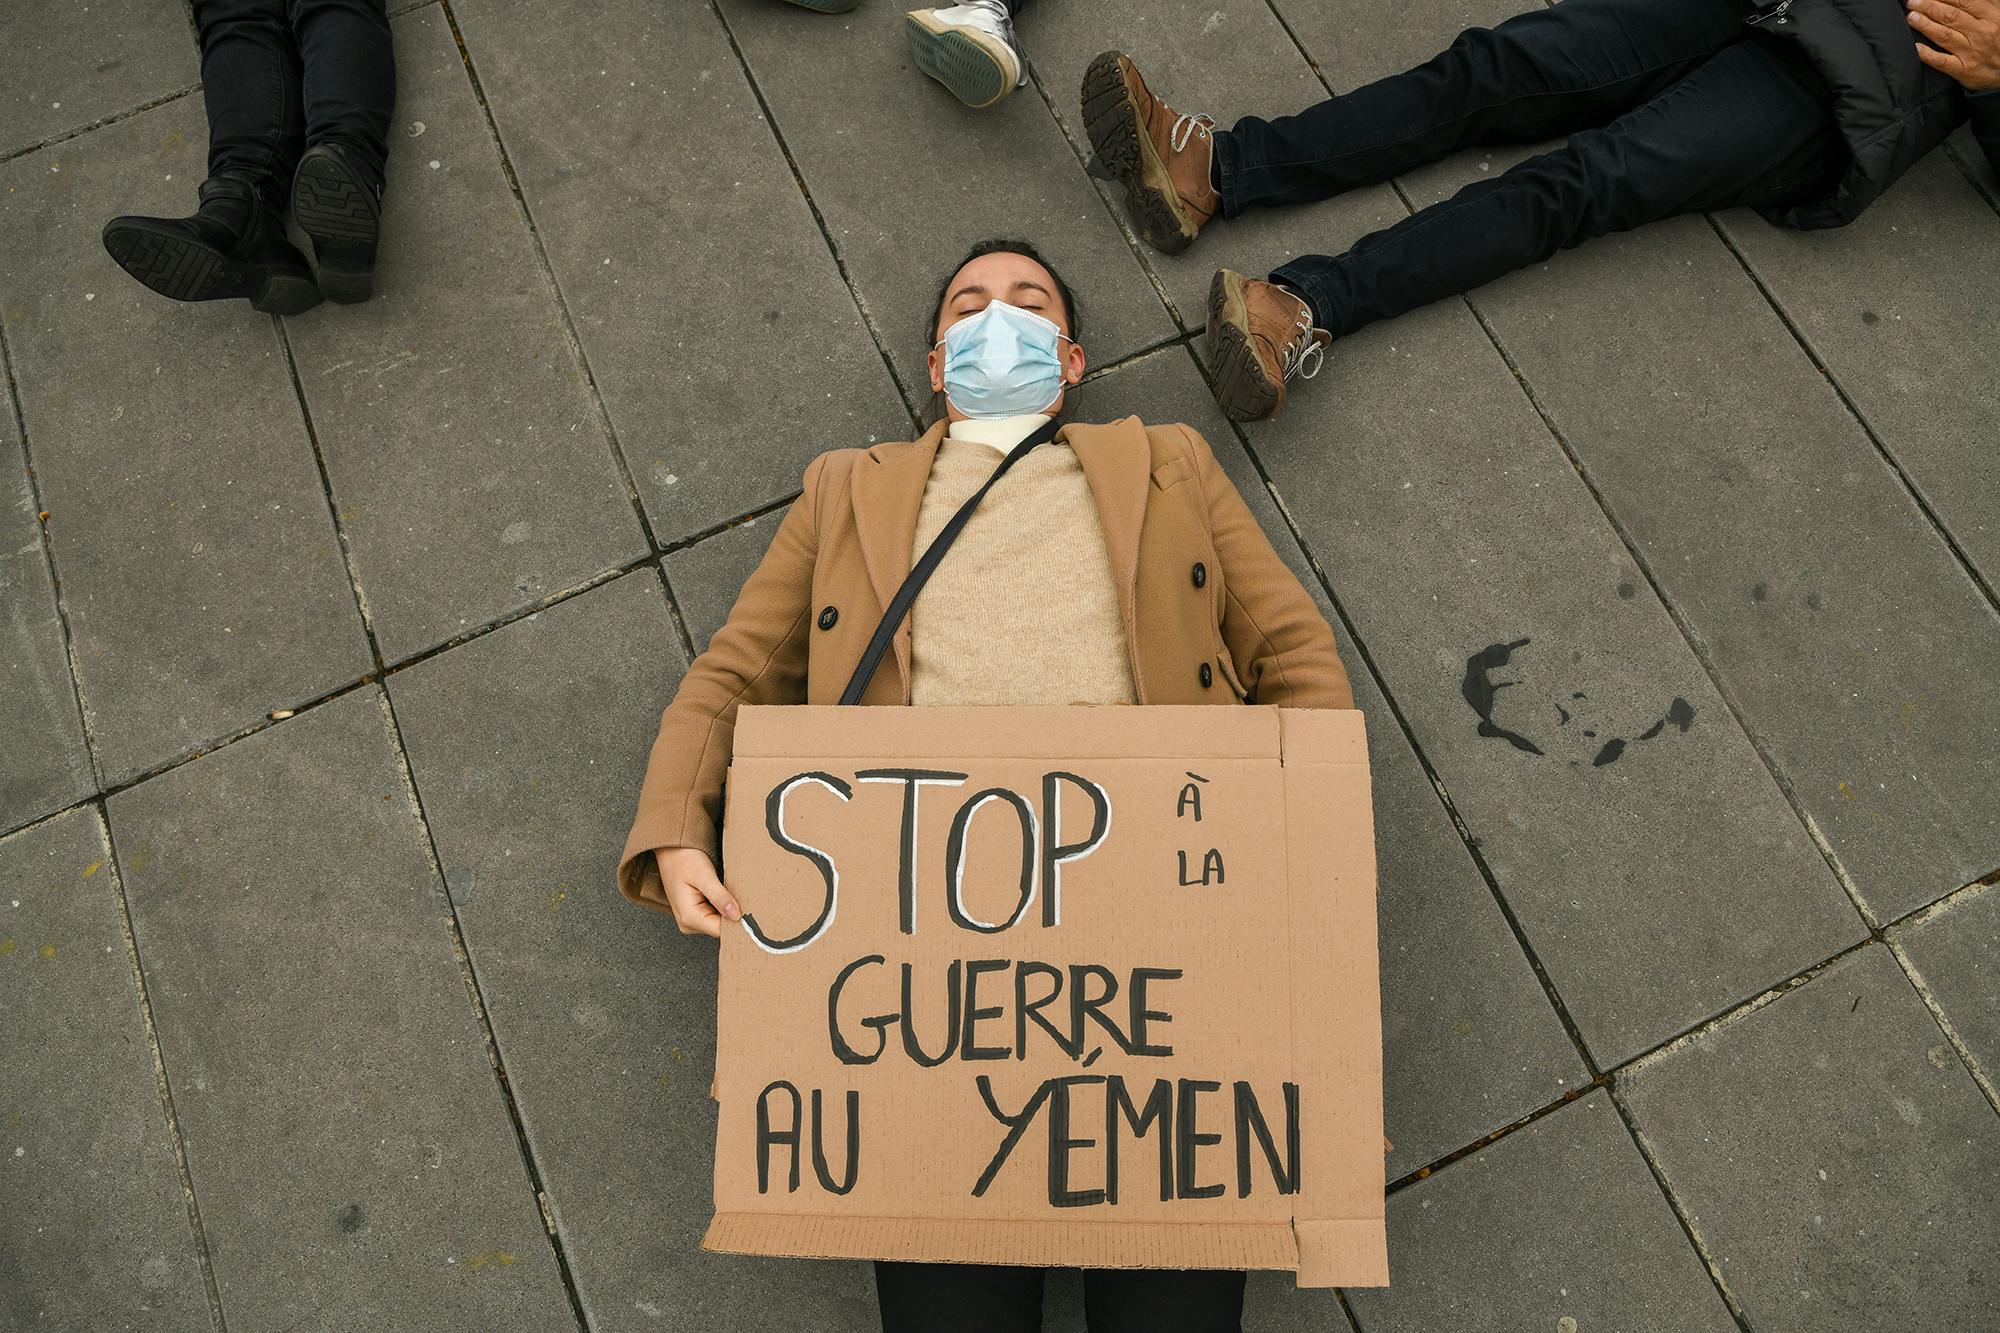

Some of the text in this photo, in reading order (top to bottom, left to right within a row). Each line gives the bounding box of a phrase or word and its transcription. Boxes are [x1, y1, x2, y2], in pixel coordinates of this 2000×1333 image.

[1177, 771, 1210, 822] À
[741, 768, 1112, 955] STOP
[1177, 848, 1225, 887] LA
[828, 954, 1184, 1067] GUERRE
[756, 1046, 1301, 1208] AU YÉMEN
